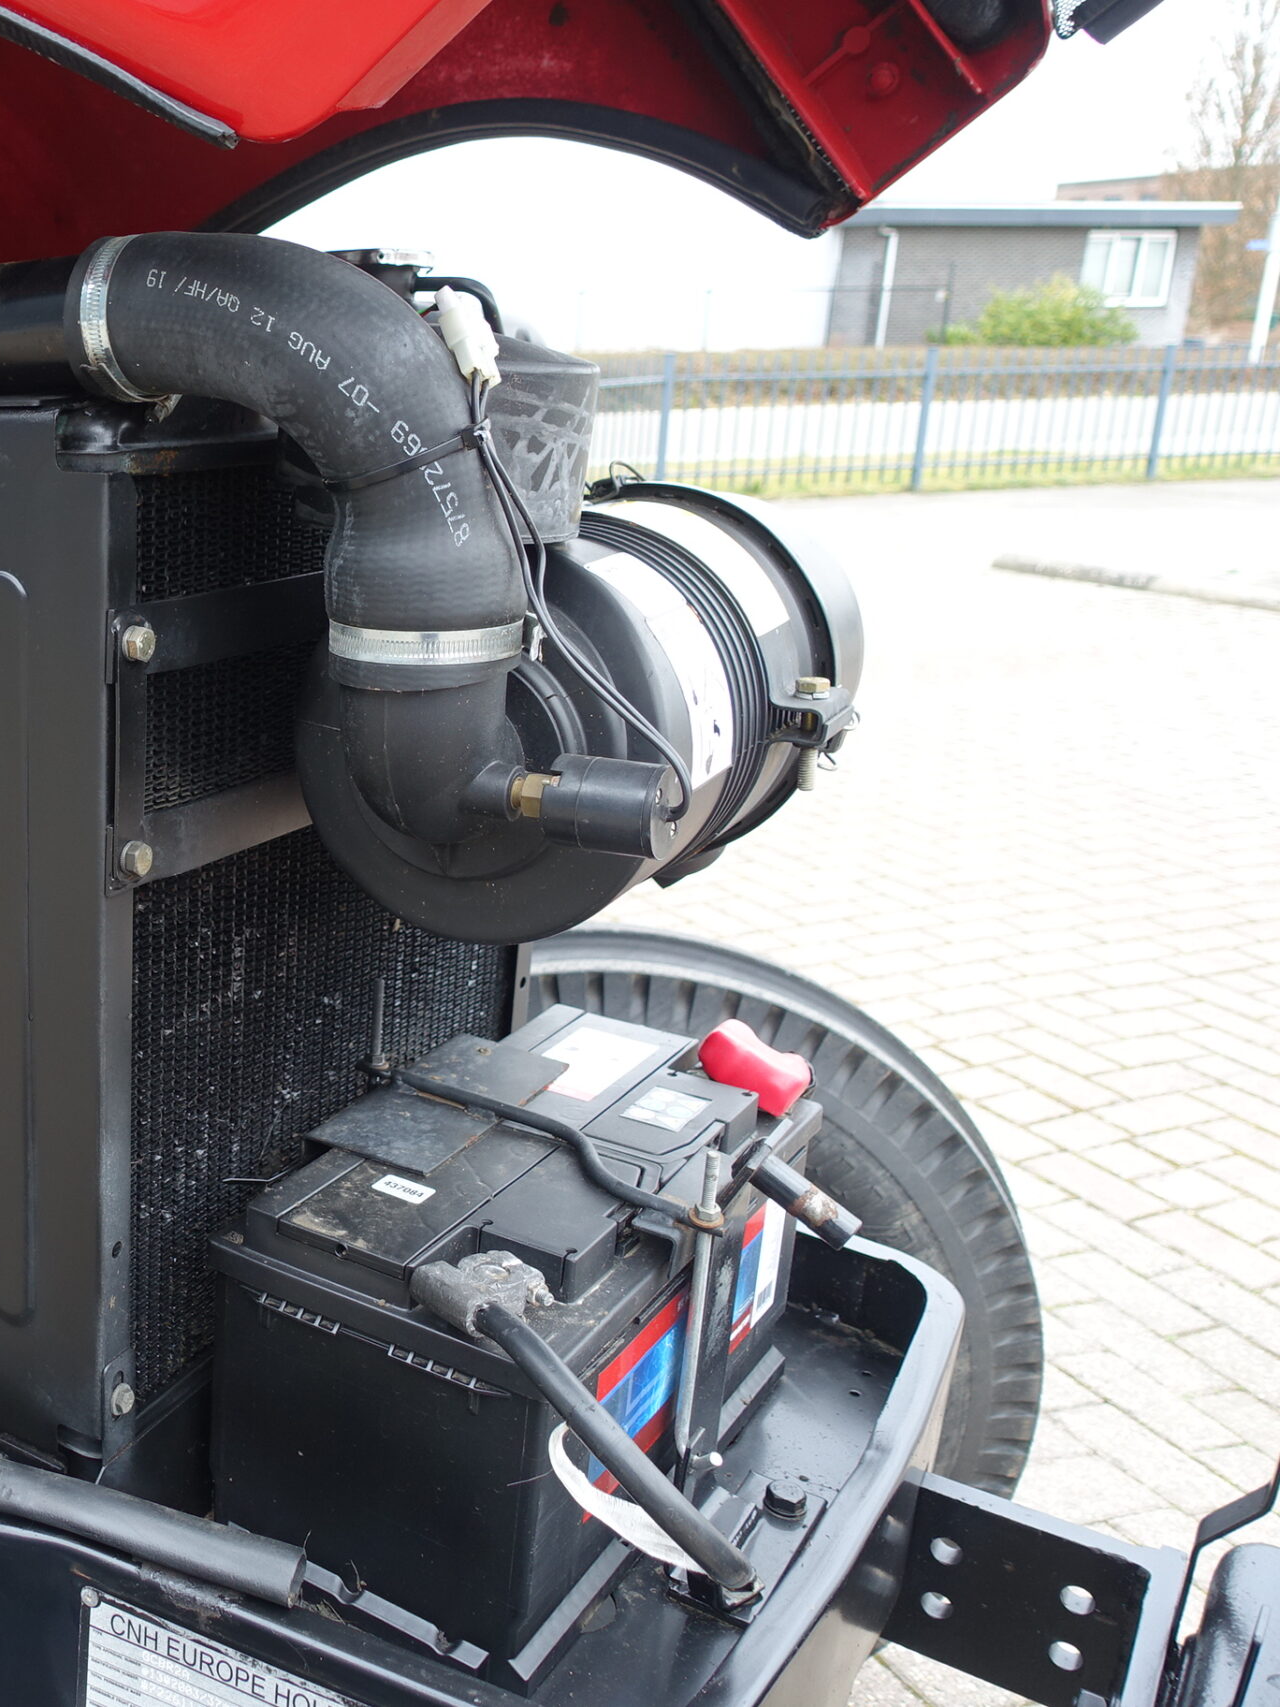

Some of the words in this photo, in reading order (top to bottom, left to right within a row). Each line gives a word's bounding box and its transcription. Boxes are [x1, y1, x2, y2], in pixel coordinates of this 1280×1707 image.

[250, 306, 276, 332] 12
[287, 331, 331, 370] AUG
[391, 420, 470, 547] 8757269
[383, 1181, 424, 1198] 437084
[109, 1613, 159, 1652] CNH
[166, 1636, 266, 1700] EUROPE
